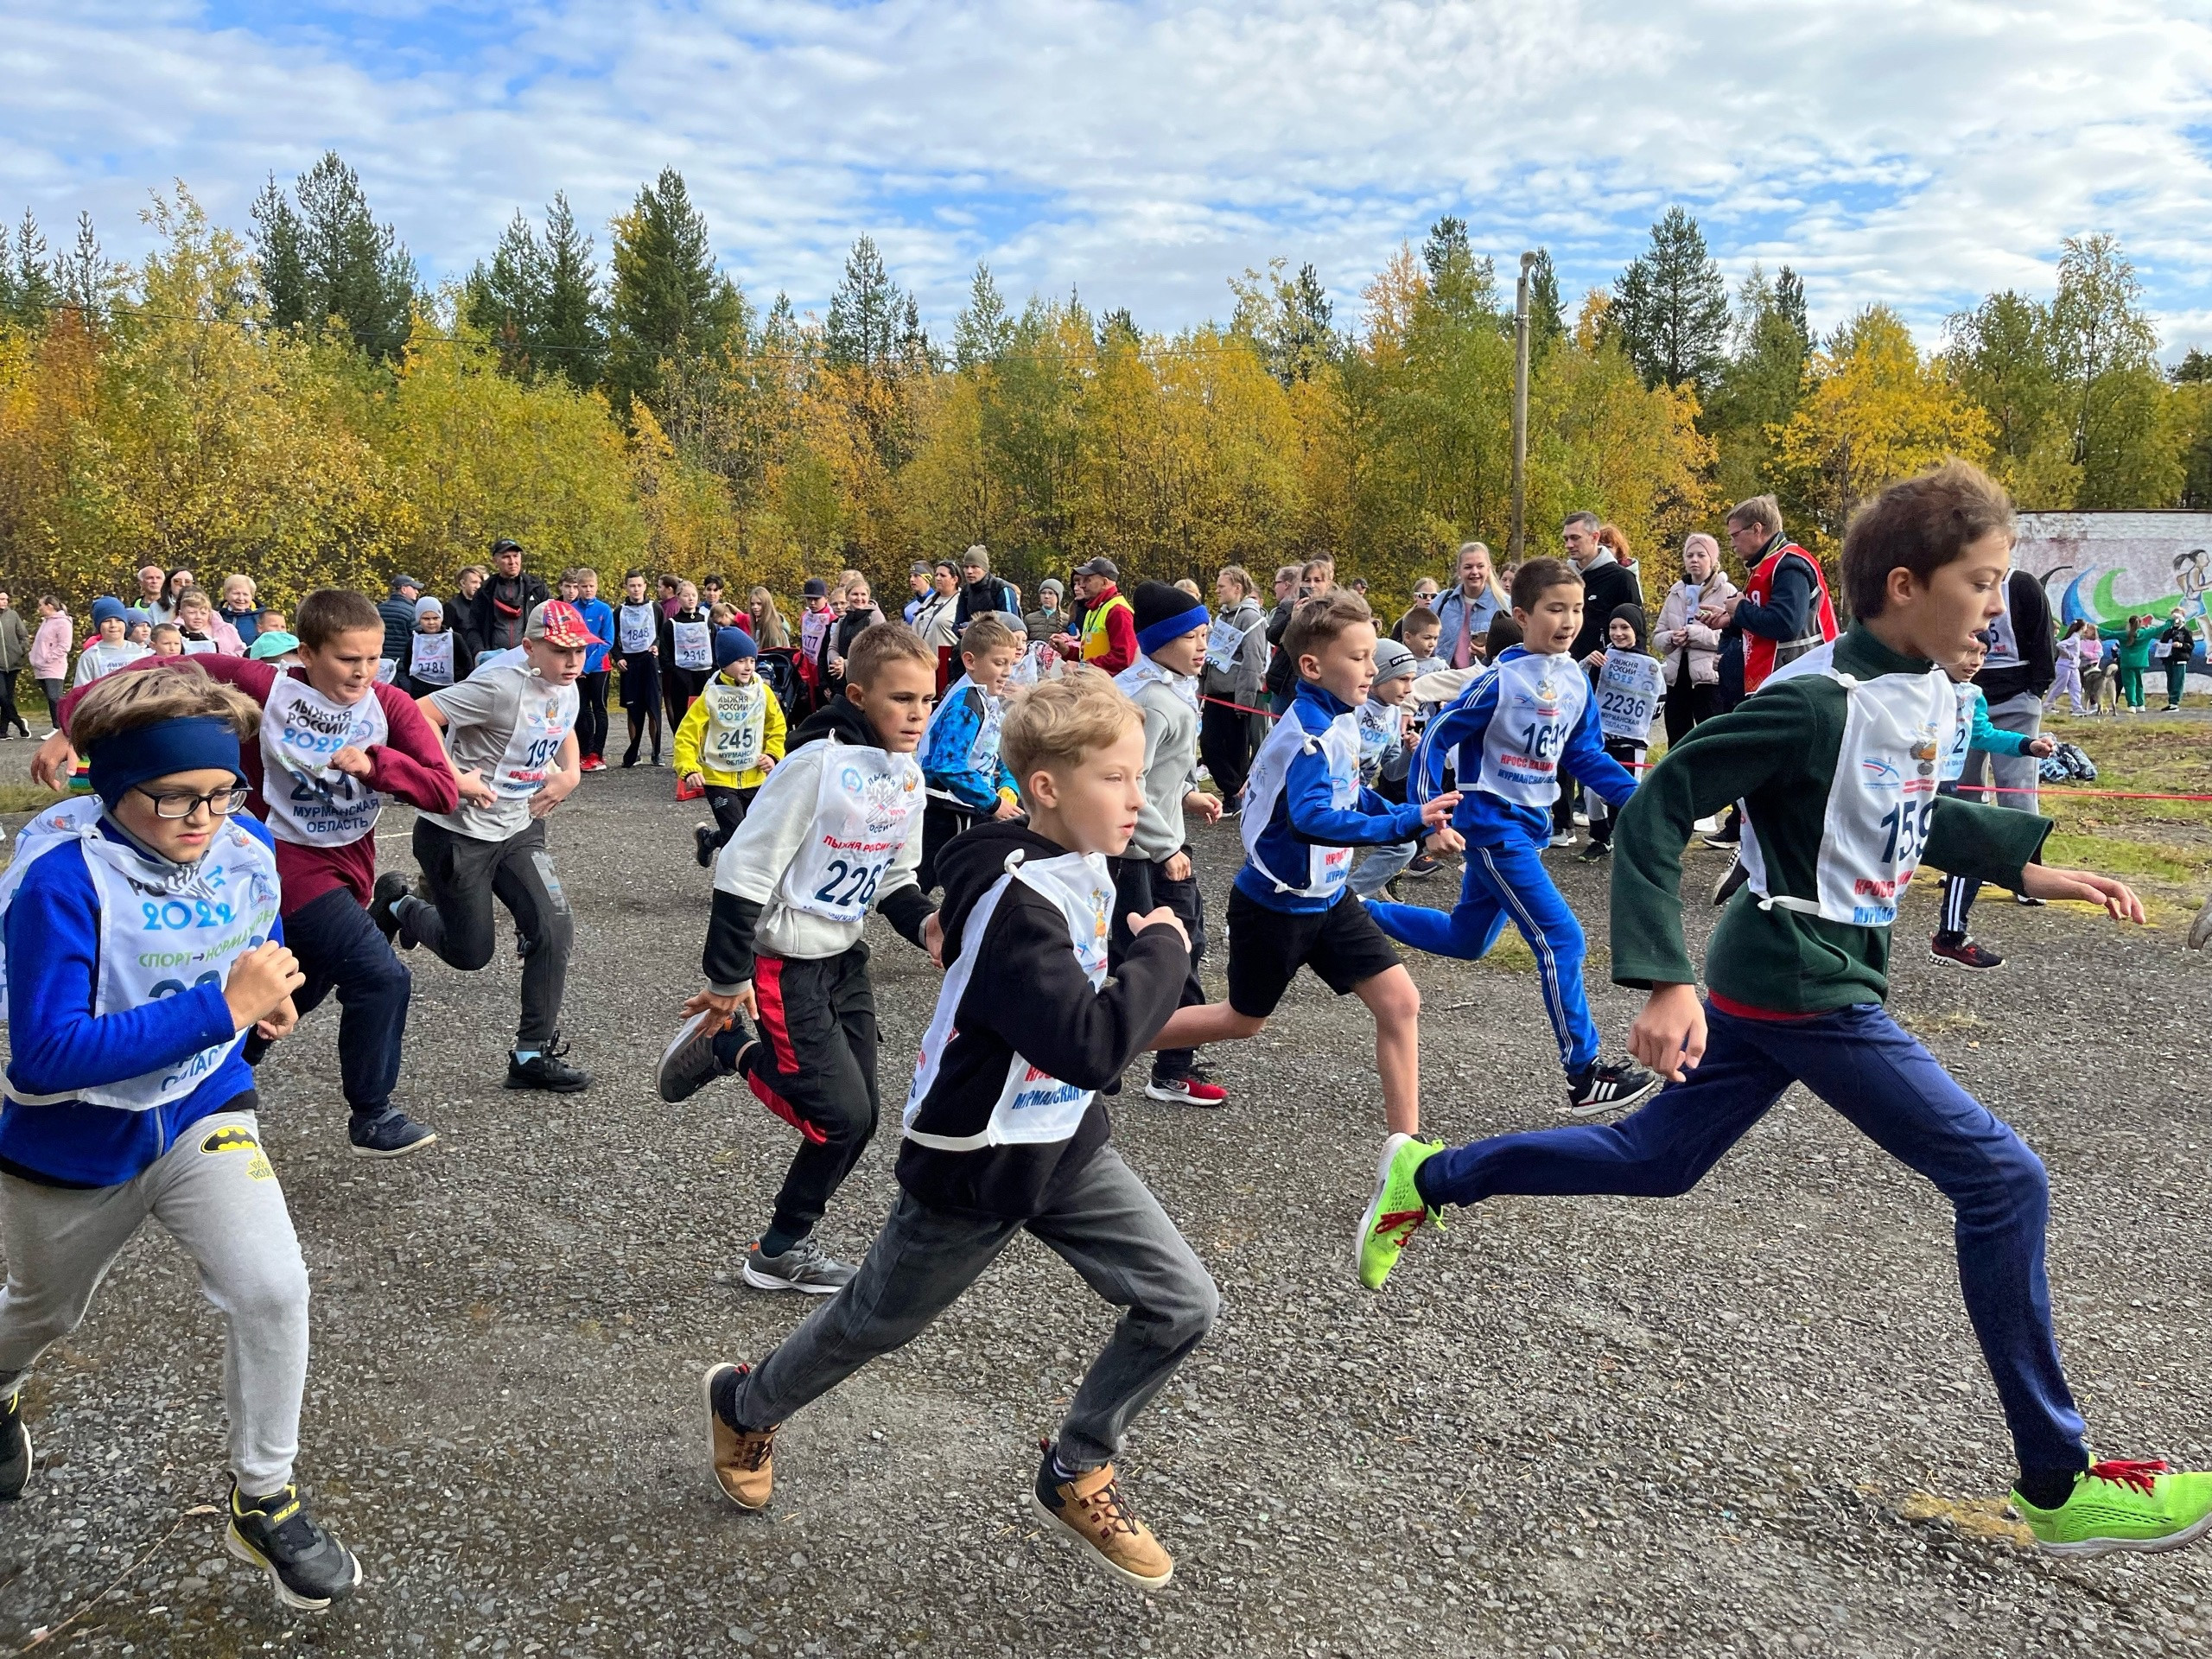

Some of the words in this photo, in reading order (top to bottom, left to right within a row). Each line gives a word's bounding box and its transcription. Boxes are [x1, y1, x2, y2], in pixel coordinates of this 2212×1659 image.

[627, 628, 649, 640] 1848
[683, 650, 706, 661] 2316
[1611, 658, 1639, 669] ЛЫЖНЯ
[418, 662, 445, 674] 2786
[1609, 664, 1637, 676] РОССИИ
[1608, 671, 1634, 683] 2022
[288, 699, 353, 721] ЛЫЖНЯ
[1601, 692, 1645, 717] 2236
[286, 712, 352, 734] РОССИИ
[1601, 712, 1640, 726] МУРМАНСКАЯ
[282, 728, 345, 753] 2022
[717, 728, 757, 750] 245
[727, 758, 753, 766] ОБЛАСТЬ
[1501, 753, 1528, 767] КРОСС
[293, 798, 380, 817] МУРМАНСКАЯ
[307, 817, 369, 833] ОБЛАСТЬ
[823, 835, 861, 851] ЛЫЖНЯ
[1853, 879, 1896, 899] КРОСС
[142, 901, 238, 931] 2022
[138, 949, 192, 968] СПОРТ
